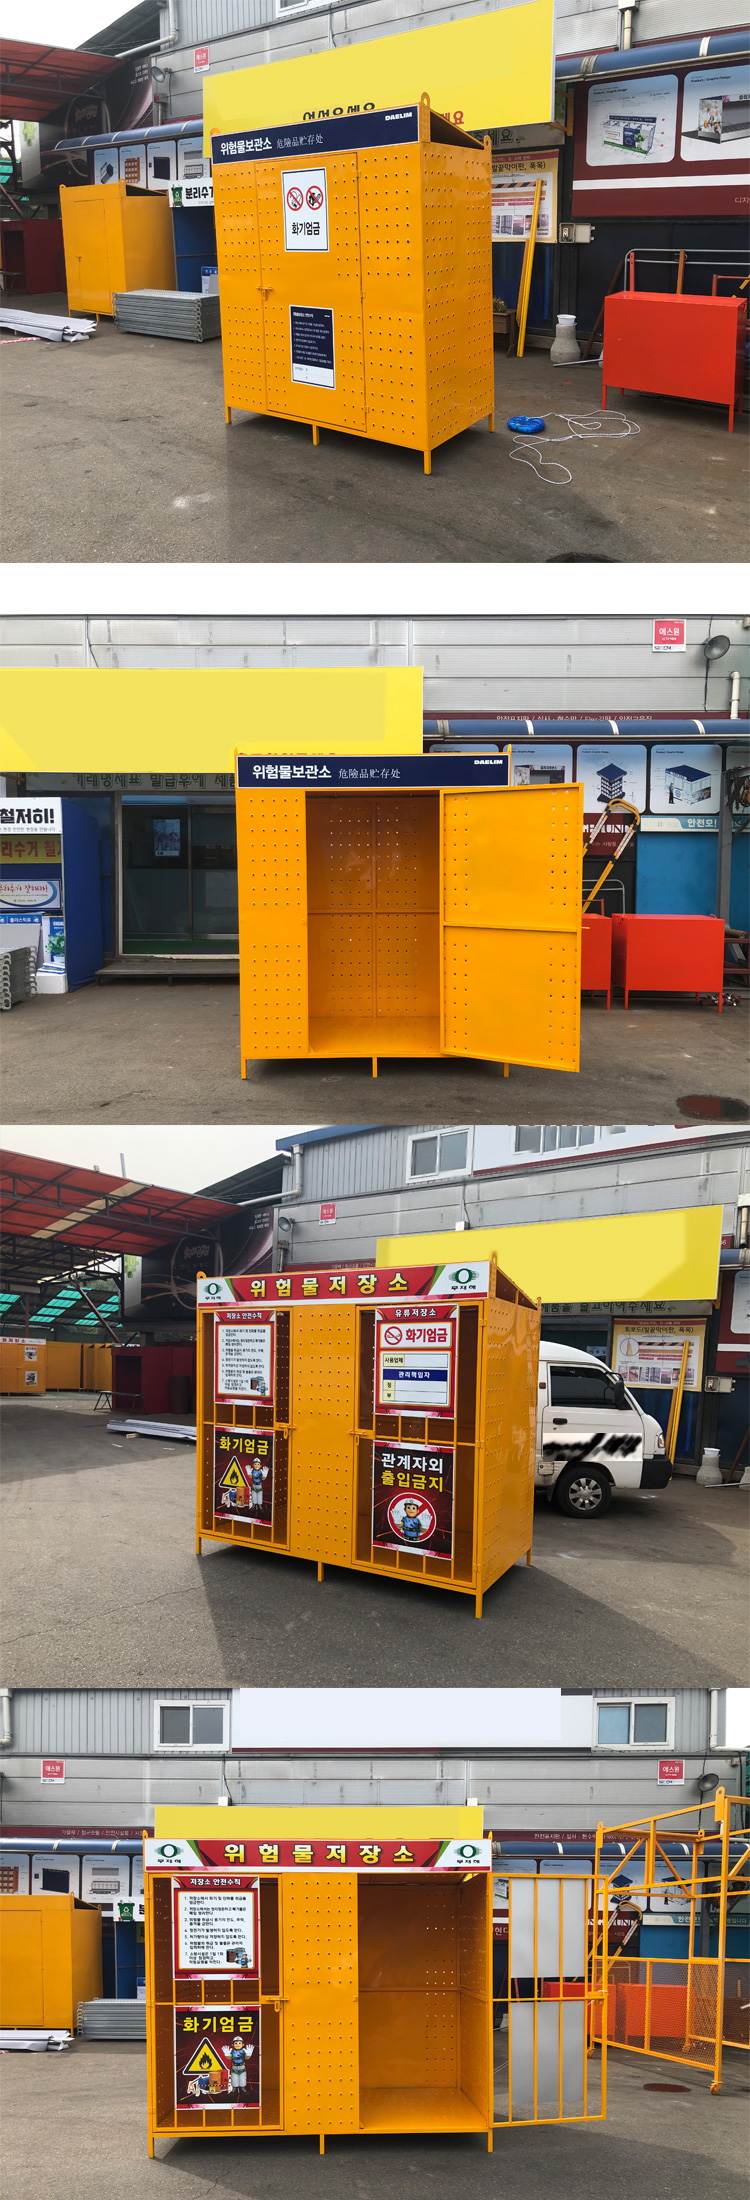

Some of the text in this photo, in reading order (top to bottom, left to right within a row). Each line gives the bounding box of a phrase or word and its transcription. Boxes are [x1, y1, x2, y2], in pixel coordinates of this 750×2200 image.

[384, 111, 413, 121] DAELIM
[220, 136, 272, 156] 위험물보관소
[291, 221, 320, 236] 화기엄금
[658, 627, 680, 636] 에스원
[252, 764, 332, 780] 위험물보관소
[0, 808, 54, 824] 철저히!
[687, 818, 717, 828] 안전모!
[249, 1272, 408, 1298] 위험물저장소
[395, 1308, 437, 1317] 유류저장소
[405, 1327, 448, 1343] 화기엄금
[398, 1370, 431, 1379] 관리책임자
[219, 1436, 269, 1456] 화기엄금
[381, 1452, 444, 1474] 관계자외
[381, 1469, 444, 1493] 출입금지
[223, 1843, 415, 1864] 위험물저장소
[190, 1878, 241, 1886] 저장소 안전수칙
[182, 2016, 254, 2033] 화기엄금
